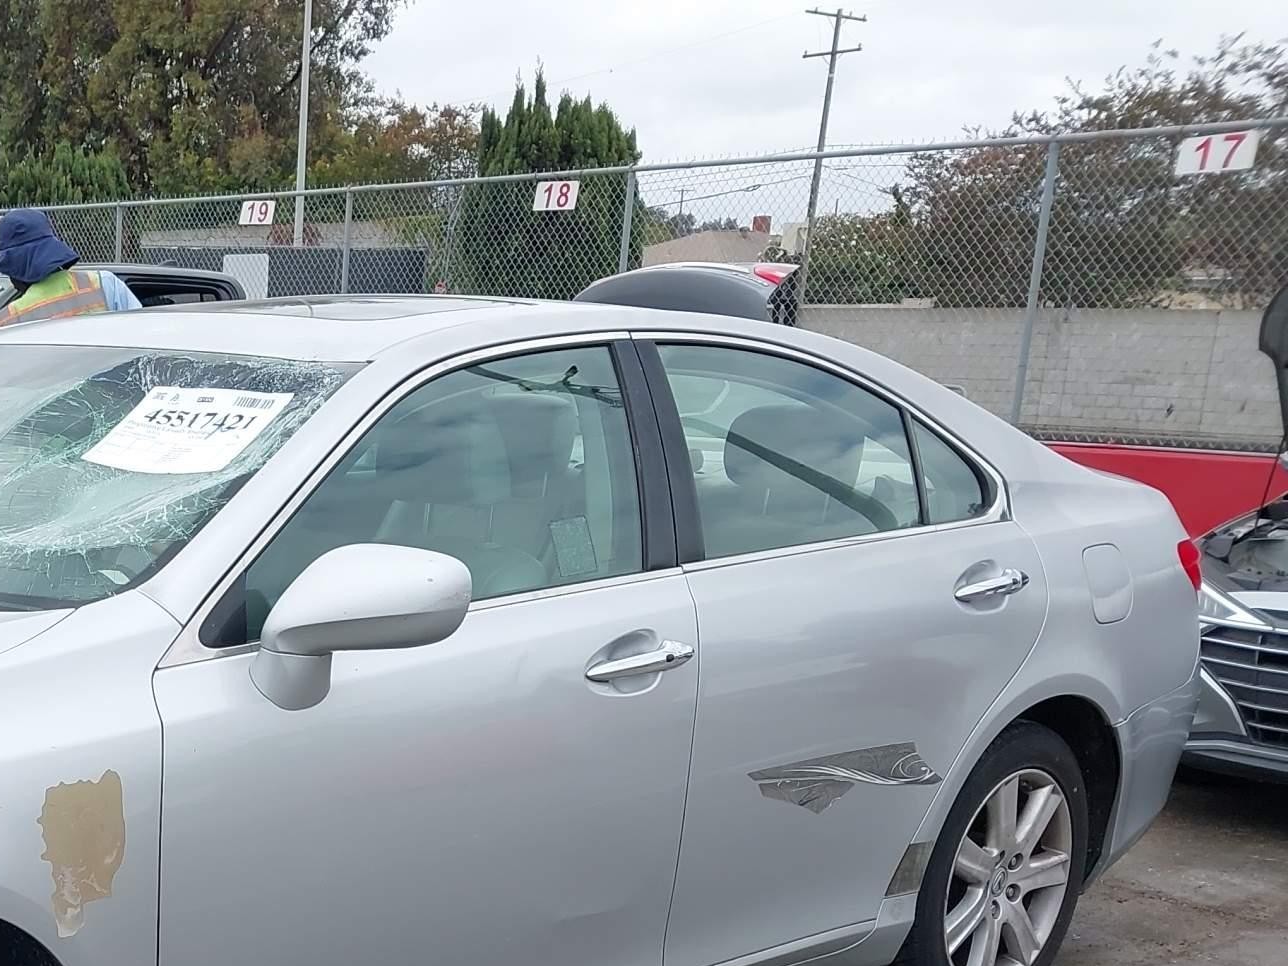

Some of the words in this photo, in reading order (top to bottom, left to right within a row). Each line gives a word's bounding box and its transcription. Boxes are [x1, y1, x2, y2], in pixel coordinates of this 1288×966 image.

[1195, 133, 1248, 170] 17
[544, 182, 571, 208] 18
[248, 201, 269, 223] 19
[144, 408, 258, 431] 45517421
